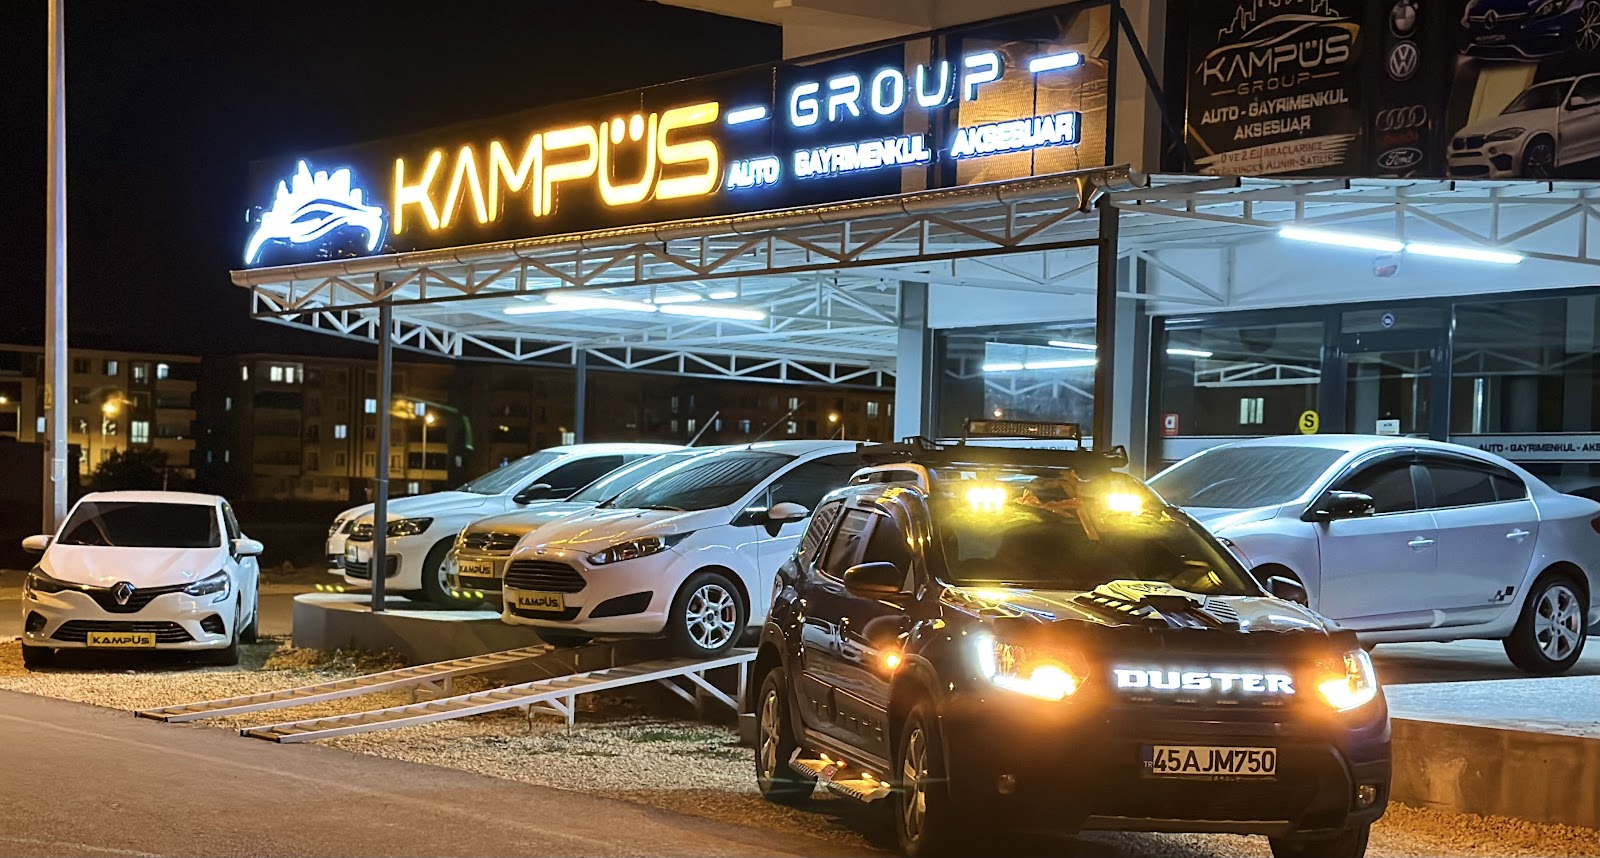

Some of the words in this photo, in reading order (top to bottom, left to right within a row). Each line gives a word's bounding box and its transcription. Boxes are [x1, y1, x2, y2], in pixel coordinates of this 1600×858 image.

[1202, 32, 1351, 87] KAMPÜS
[790, 51, 1003, 127] GROUP
[1236, 71, 1311, 96] GROUP
[1200, 105, 1239, 126] AUTO
[1233, 114, 1312, 141] AKSESUAR
[727, 156, 780, 190] AUTO
[950, 112, 1080, 160] AKSESUAR
[391, 101, 721, 236] KAMPÜS
[1303, 414, 1315, 428] S
[1478, 443, 1503, 452] AUTO
[1112, 668, 1296, 695] DUSTER
[1153, 749, 1276, 773] 45AJM750
